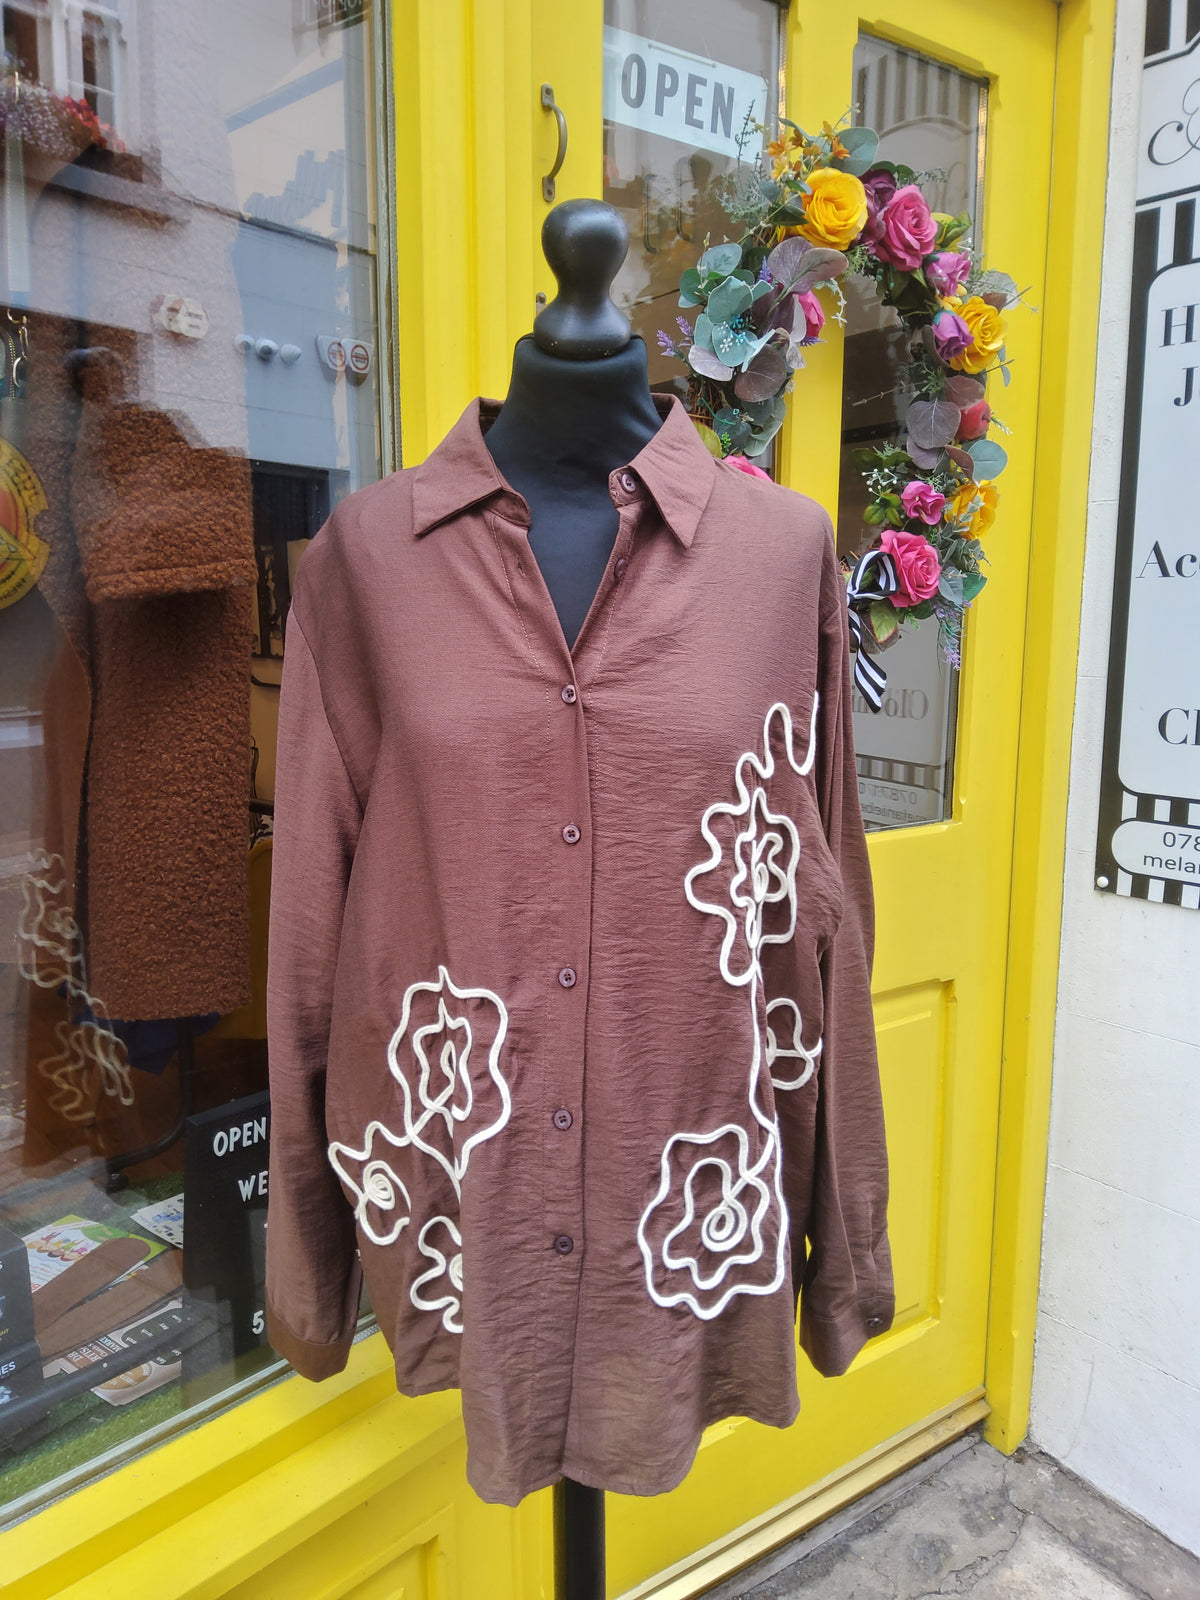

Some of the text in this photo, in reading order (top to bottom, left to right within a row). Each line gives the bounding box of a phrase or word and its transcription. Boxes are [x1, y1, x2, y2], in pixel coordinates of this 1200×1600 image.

[621, 53, 735, 139] OPEN
[1174, 366, 1200, 407] J
[1135, 540, 1200, 579] Ac
[1143, 855, 1200, 875] mela
[213, 1116, 267, 1157] OPEN
[238, 1170, 269, 1202] WE
[0, 1361, 16, 1375] ES
